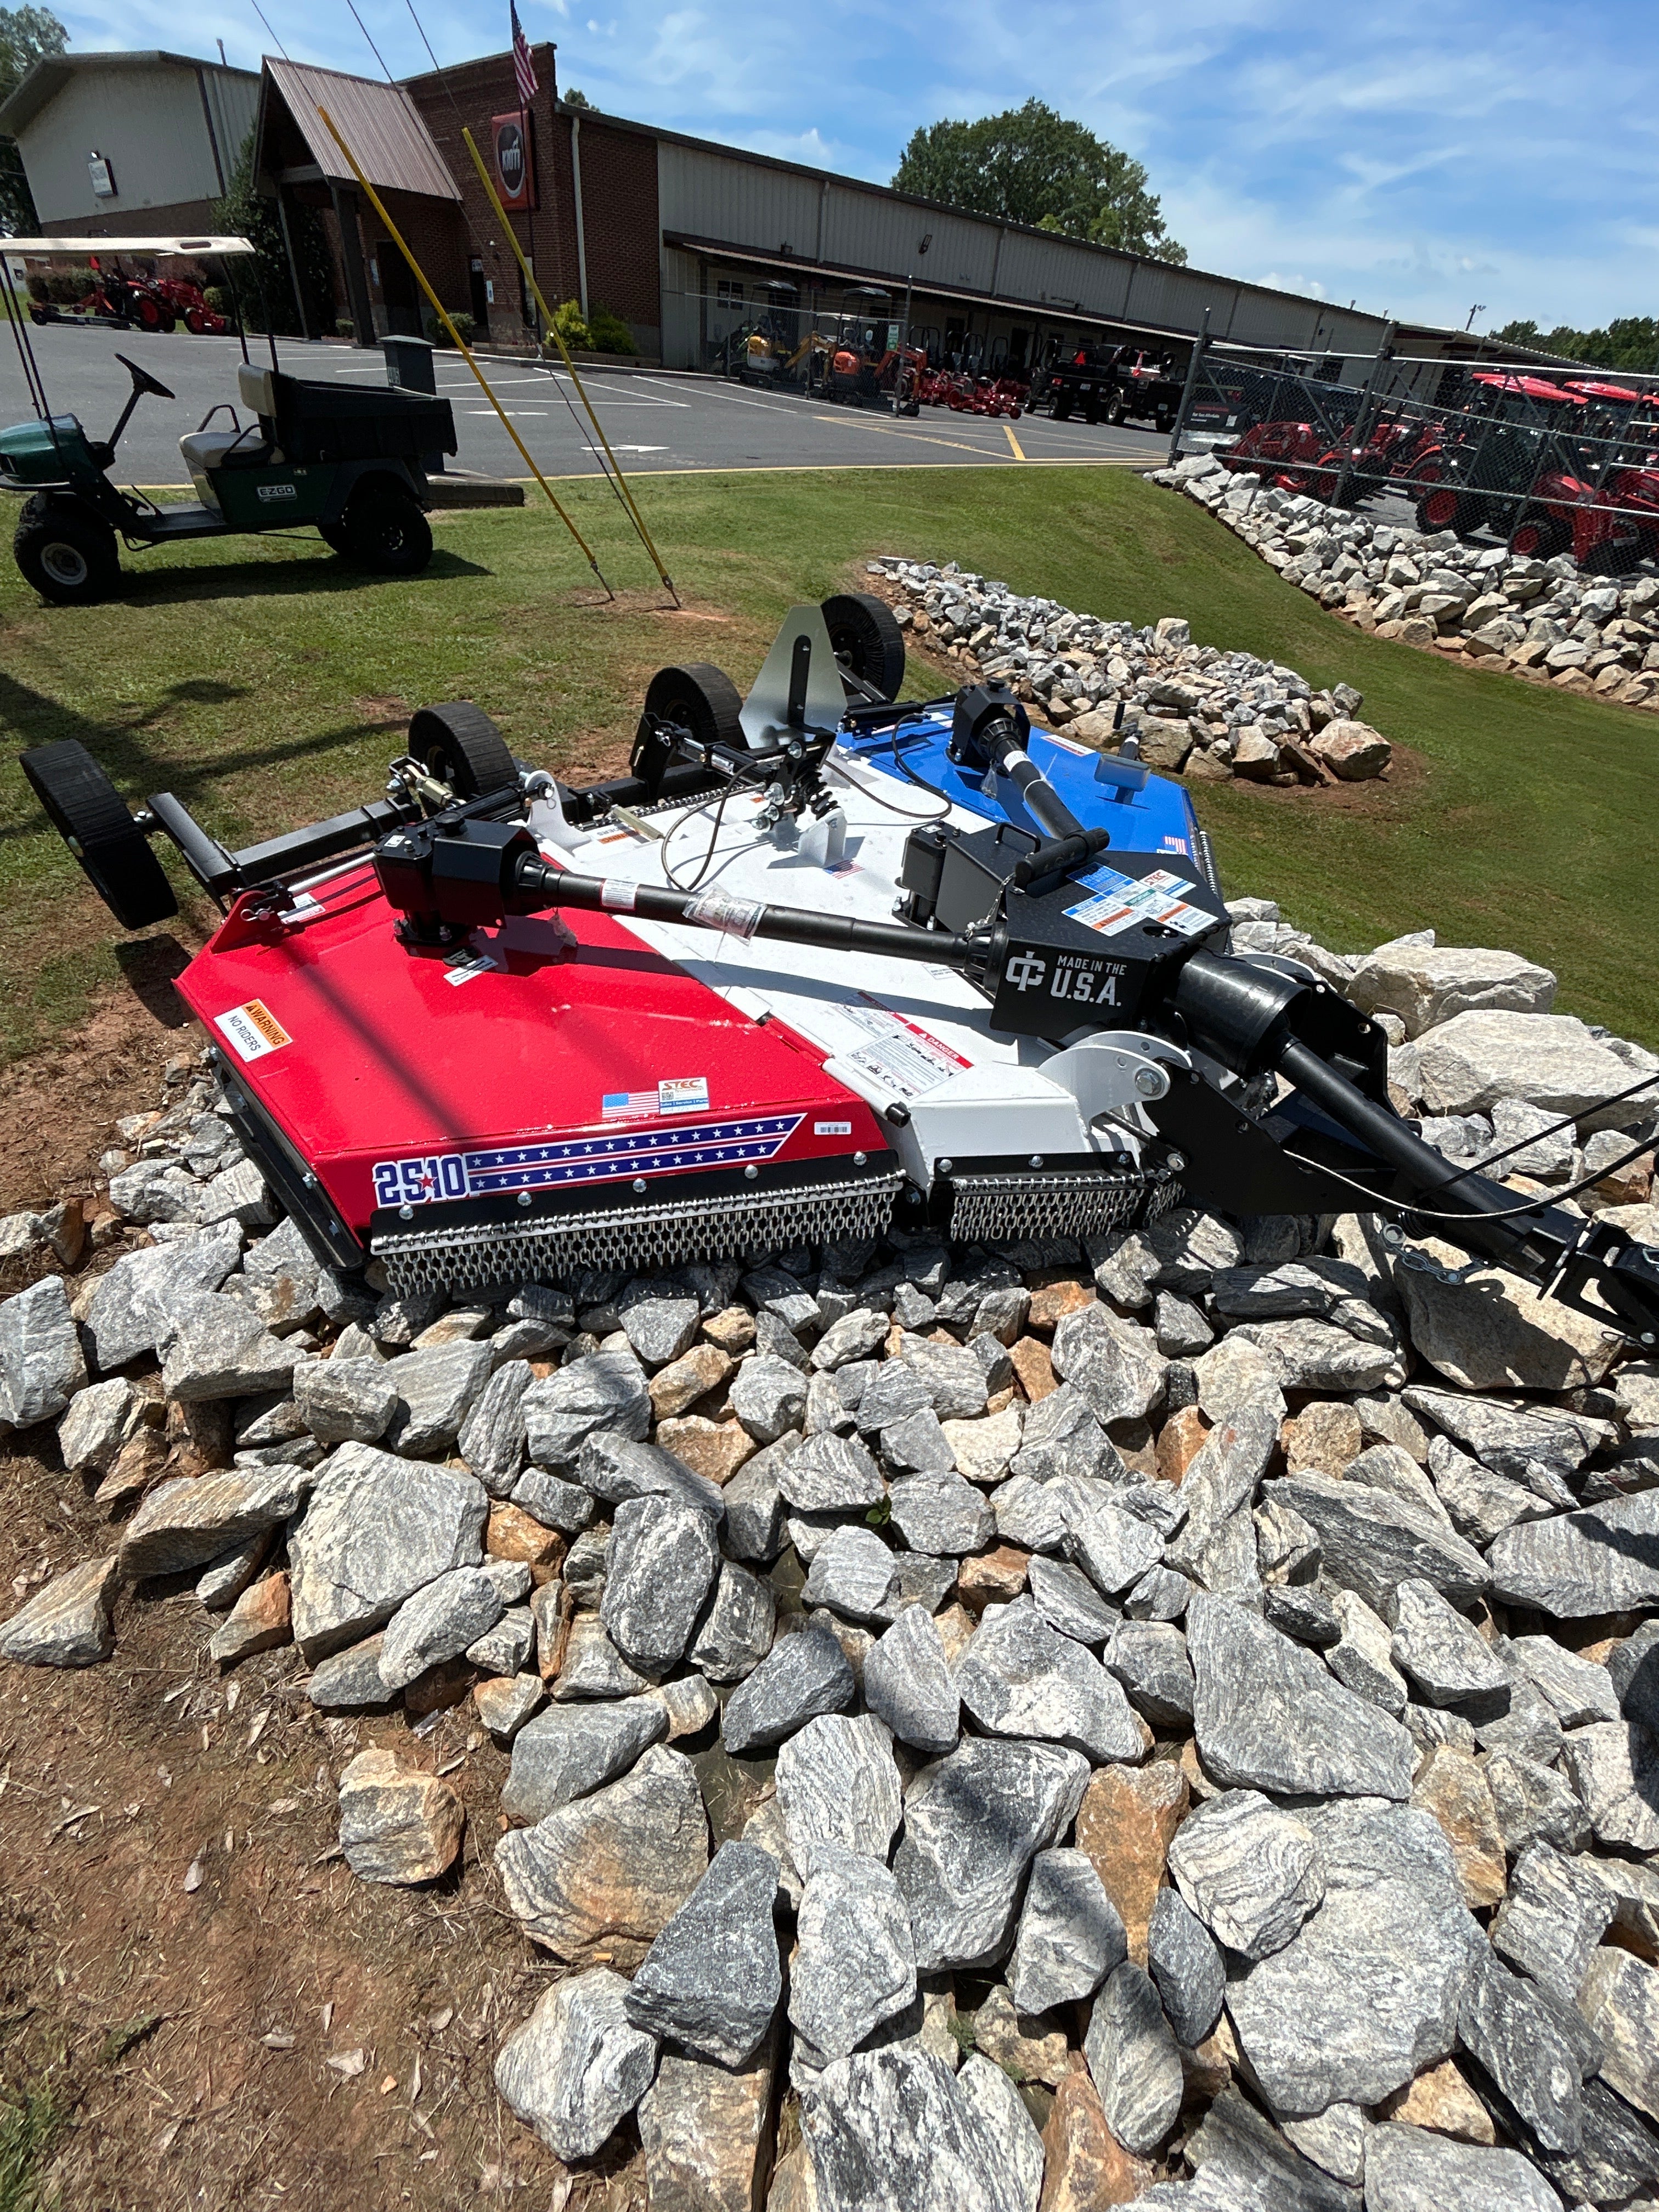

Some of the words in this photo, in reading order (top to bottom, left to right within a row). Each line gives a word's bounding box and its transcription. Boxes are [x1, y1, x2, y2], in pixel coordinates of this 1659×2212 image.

[1057, 955, 1090, 970] MADE
[1090, 960, 1103, 972] IN
[1105, 962, 1127, 975] THE
[1050, 968, 1122, 1007] U.S.A.
[228, 1015, 242, 1027] NO
[235, 1025, 261, 1051] RIDERS
[251, 1008, 285, 1045] WARNING
[926, 1037, 960, 1060] DANGER
[662, 1079, 702, 1091] STEC
[375, 1155, 467, 1205] 2510
